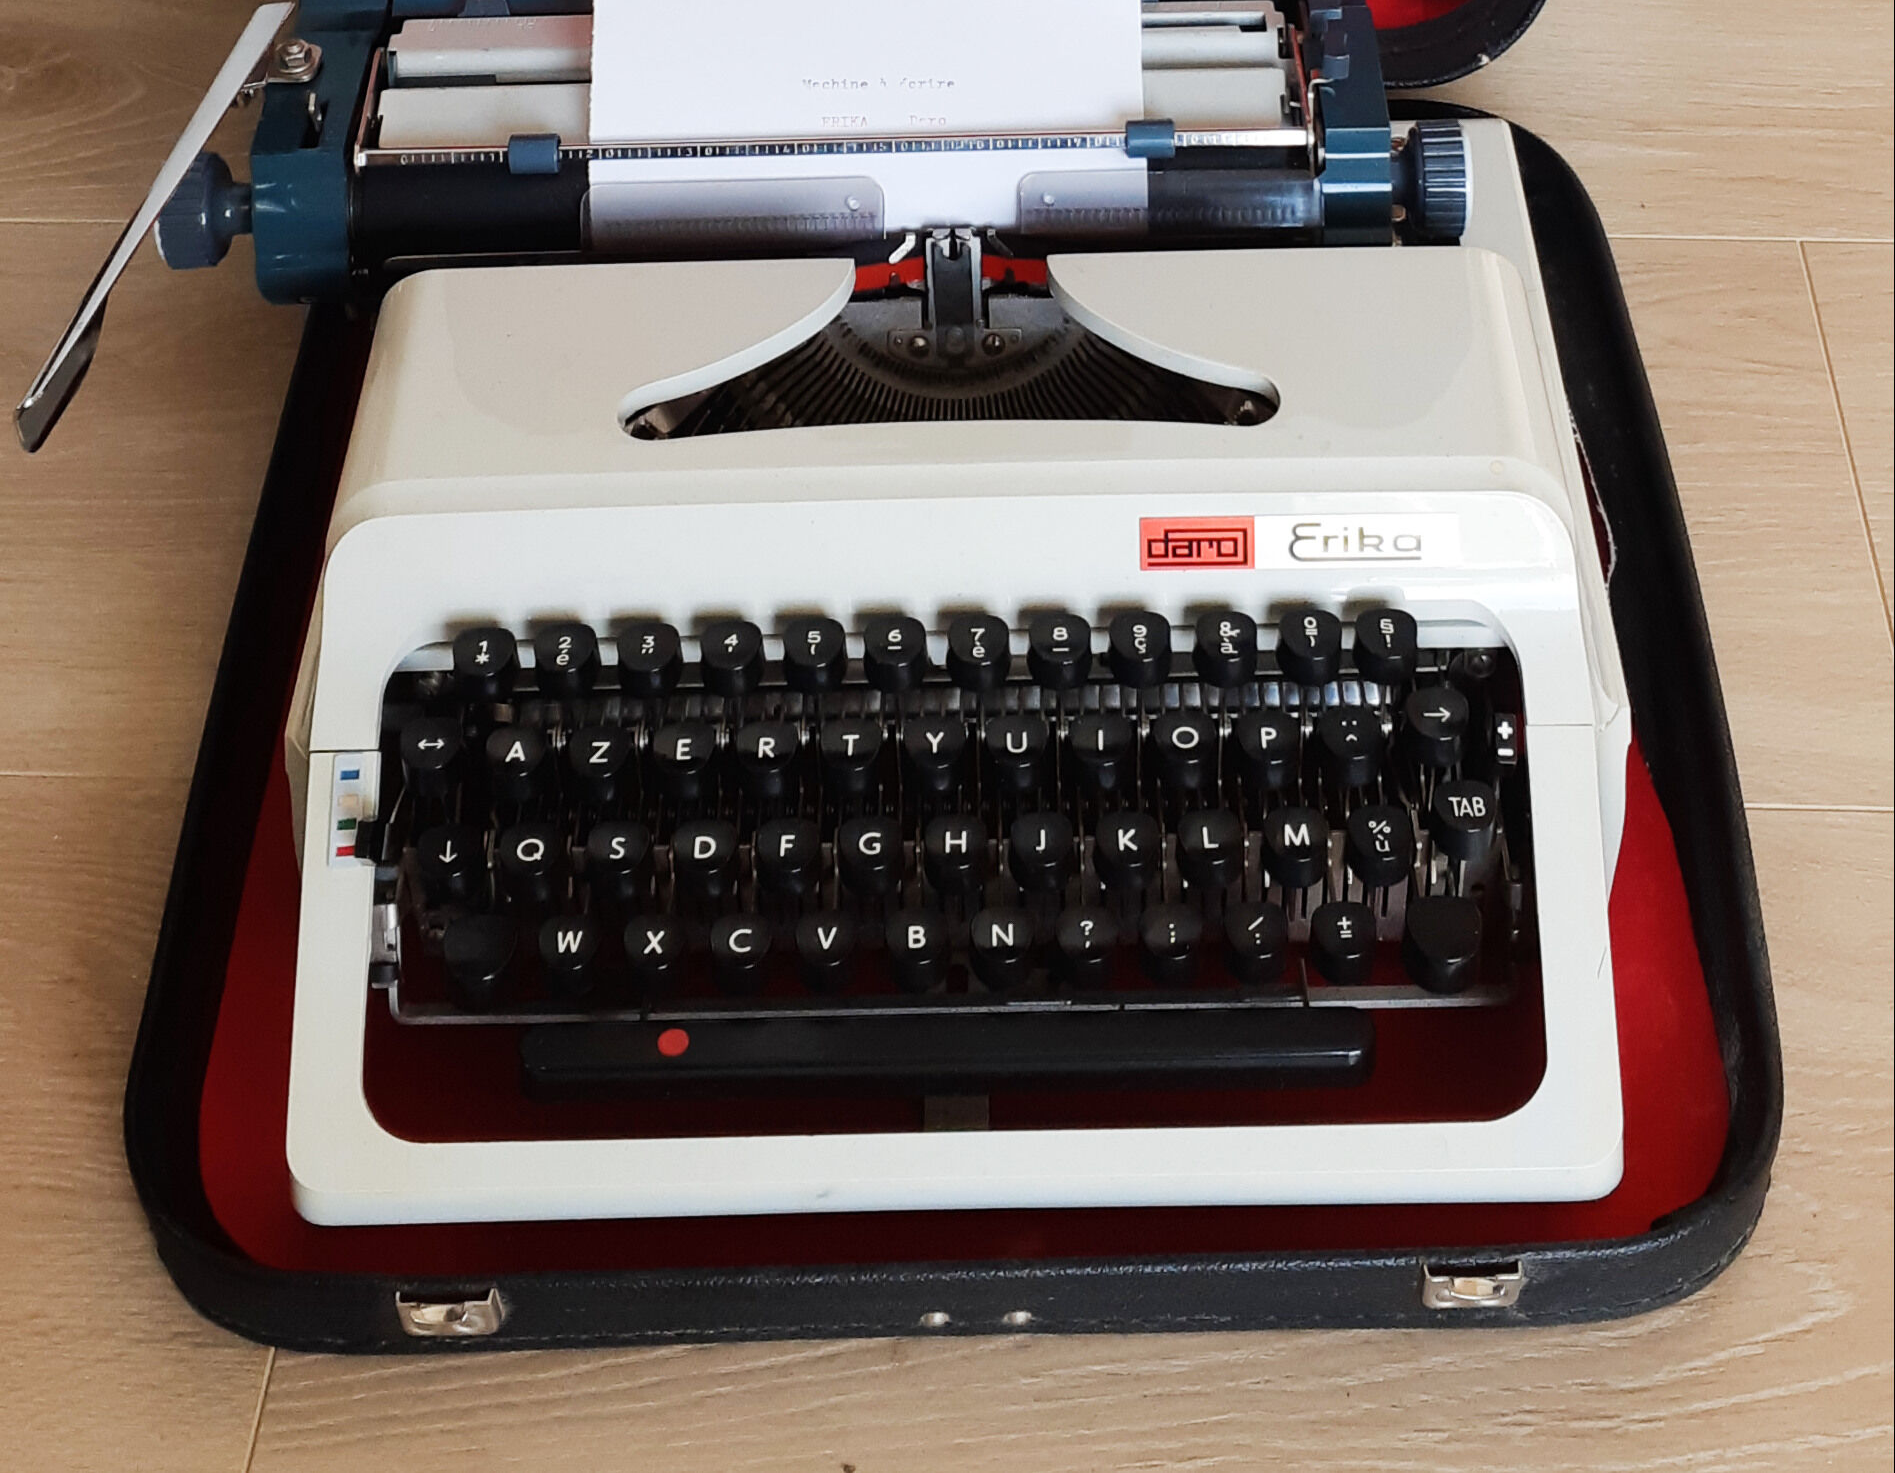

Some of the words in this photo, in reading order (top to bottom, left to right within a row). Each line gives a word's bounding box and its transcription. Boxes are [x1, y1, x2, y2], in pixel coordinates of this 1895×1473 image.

[1147, 528, 1248, 566] daro
[1289, 522, 1423, 562] Erika
[477, 640, 489, 652] 1
[558, 636, 572, 649] 2
[642, 635, 655, 648] 3
[723, 633, 739, 646] 4
[807, 630, 822, 644] 5
[887, 628, 902, 643] 6
[970, 628, 986, 641] 7
[1052, 627, 1069, 641] 8
[1132, 624, 1147, 638] 9
[556, 649, 570, 666] é
[506, 740, 526, 763] A
[589, 741, 610, 764] Z
[676, 739, 692, 761] E
[758, 737, 776, 758] R
[842, 735, 860, 757] T
[926, 731, 945, 754] Y
[1006, 732, 1028, 754] U
[1097, 729, 1105, 751] I
[1171, 727, 1200, 749] O
[1260, 727, 1277, 750] P
[1447, 796, 1486, 818] TAB
[516, 838, 545, 862] Q
[609, 836, 626, 859] S
[693, 835, 717, 859] D
[780, 834, 796, 857] F
[858, 831, 882, 855] G
[944, 830, 967, 854] H
[1035, 829, 1046, 851] J
[1118, 828, 1138, 851] K
[1202, 826, 1219, 849] L
[1284, 823, 1310, 847] M
[557, 930, 583, 953] W
[643, 930, 665, 954] X
[728, 928, 753, 953] C
[817, 926, 838, 950] V
[907, 925, 926, 949] B
[992, 923, 1014, 948] N
[1080, 920, 1094, 936] ?
